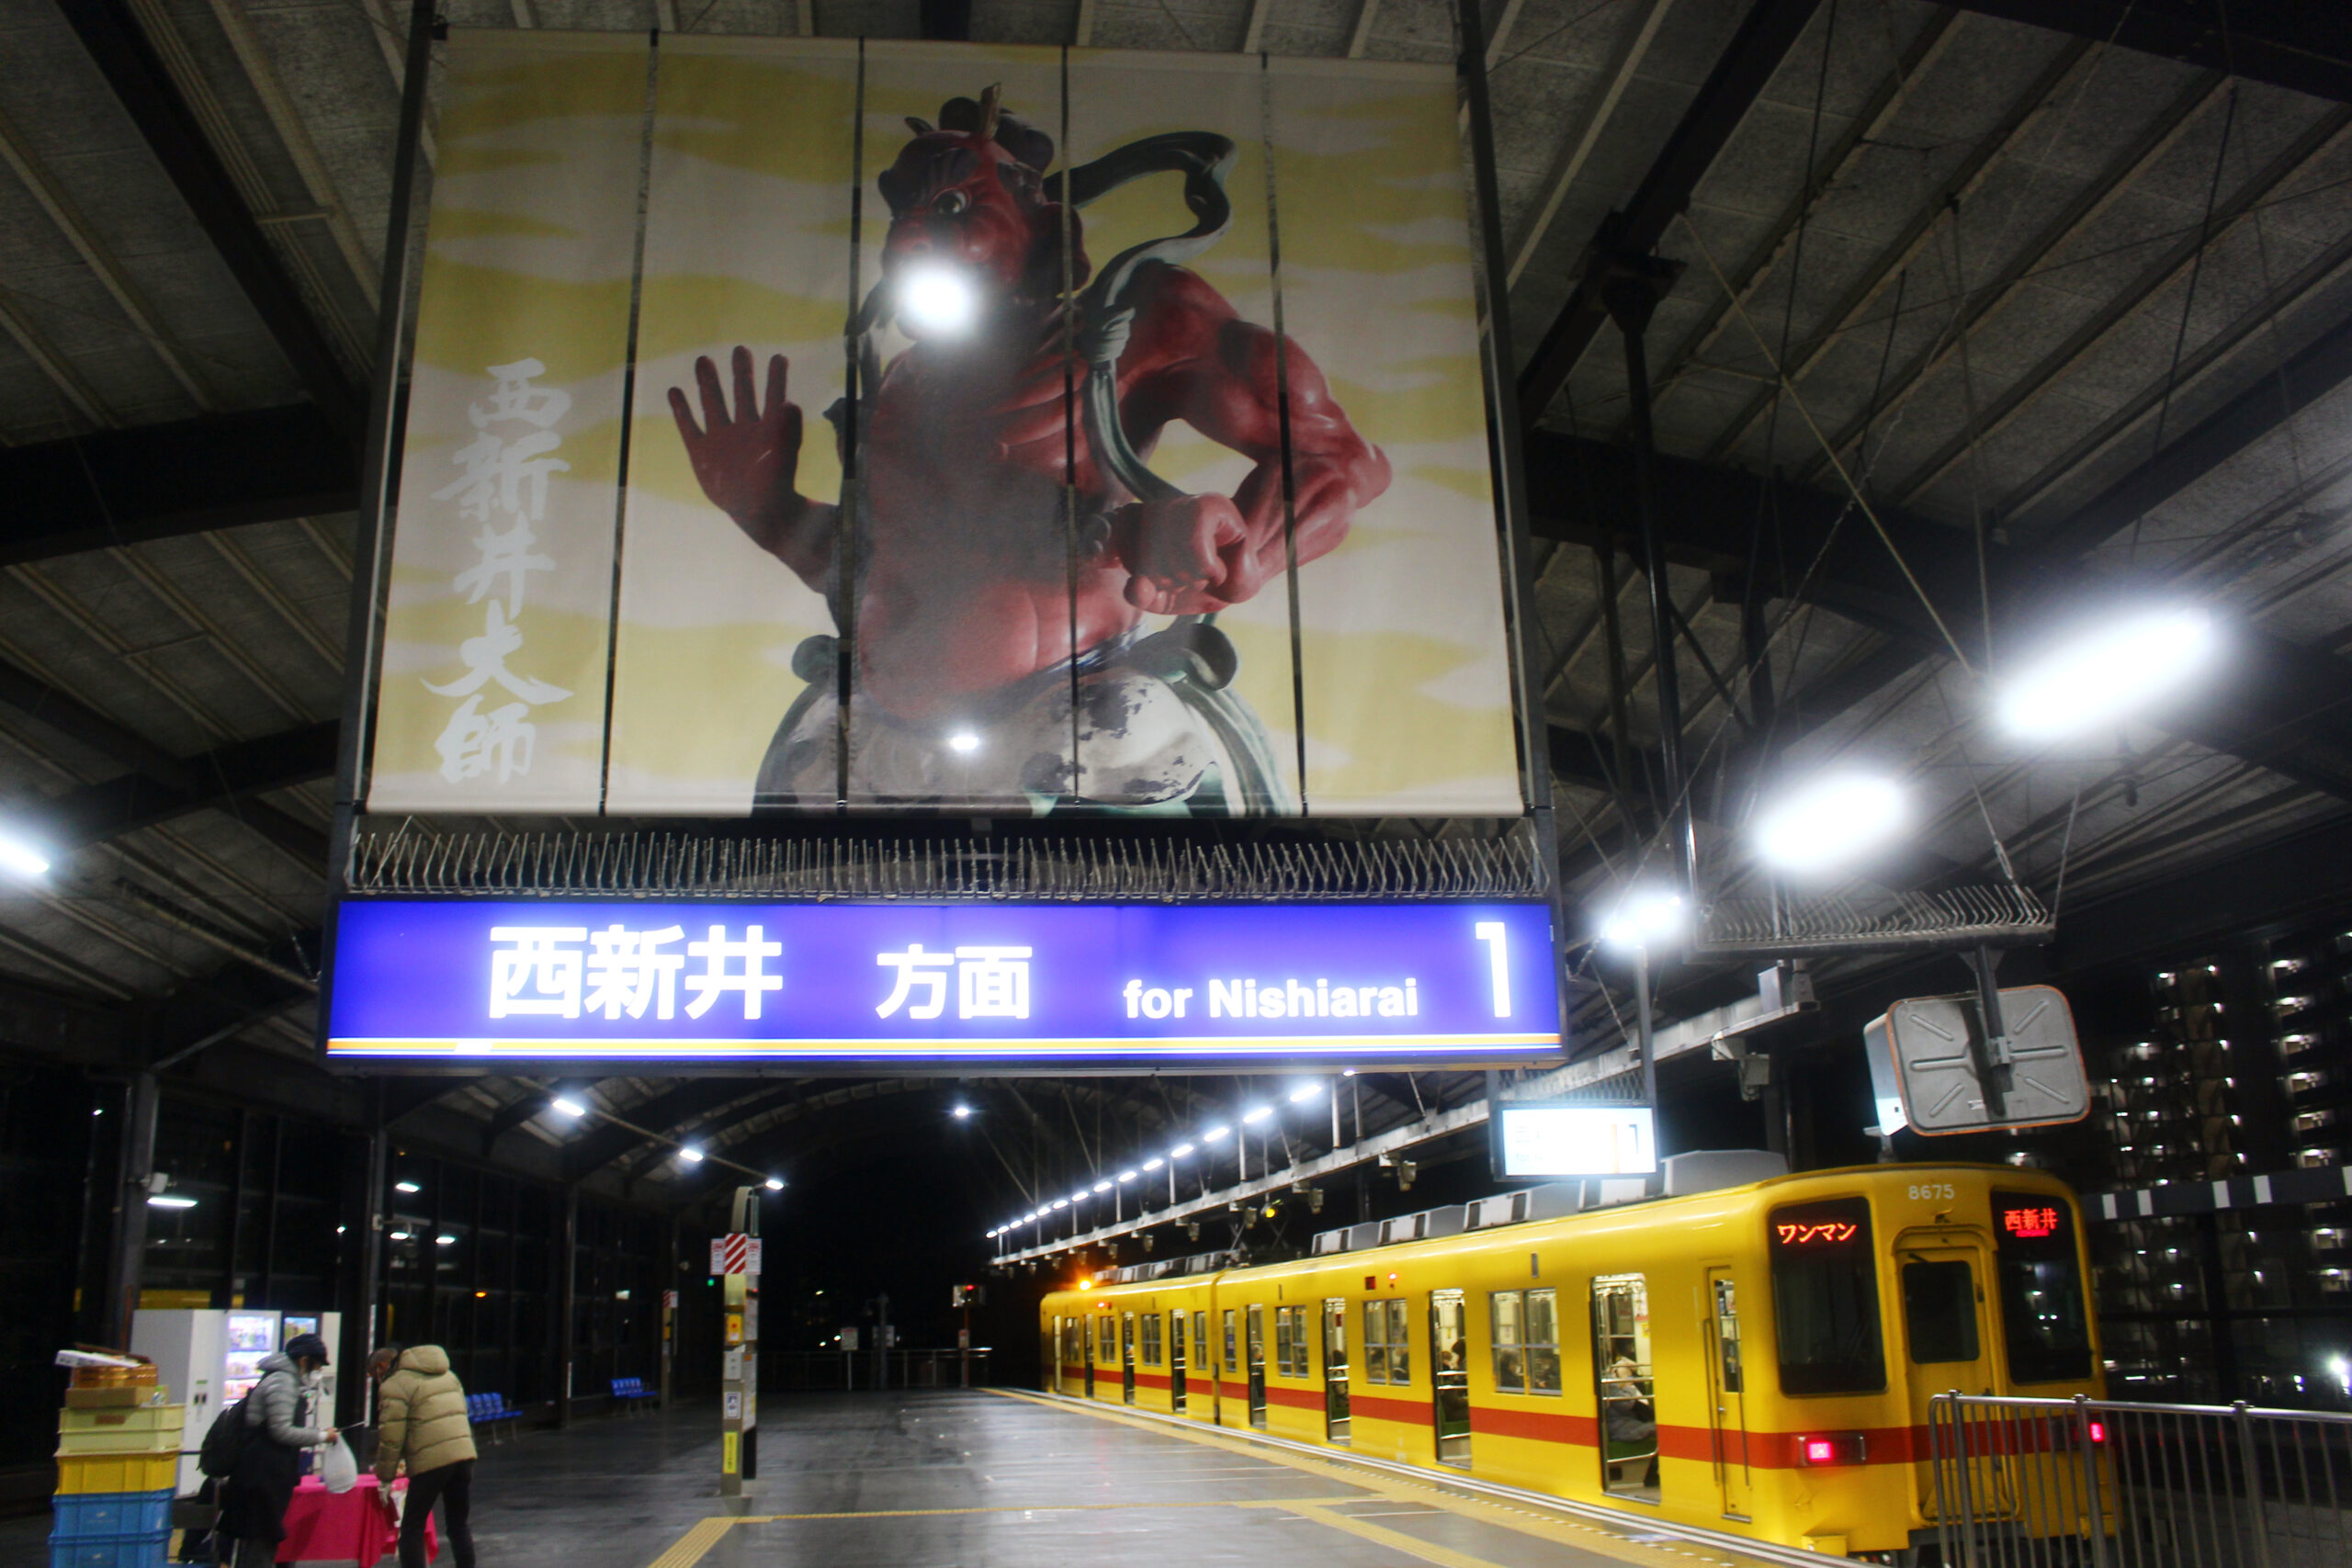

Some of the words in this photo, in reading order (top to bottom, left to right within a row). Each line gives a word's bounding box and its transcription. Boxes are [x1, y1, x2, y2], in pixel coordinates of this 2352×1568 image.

[419, 357, 574, 785] 西新井大師
[489, 924, 784, 1021] 西新井
[875, 943, 1033, 1020] 方面
[1474, 921, 1512, 1018] 1
[1123, 979, 1193, 1019] for
[1208, 977, 1419, 1018] Nishiarai
[1908, 1183, 1956, 1201] 8675
[1776, 1221, 1858, 1245] ワンマン
[2004, 1208, 2059, 1232] 西新井
